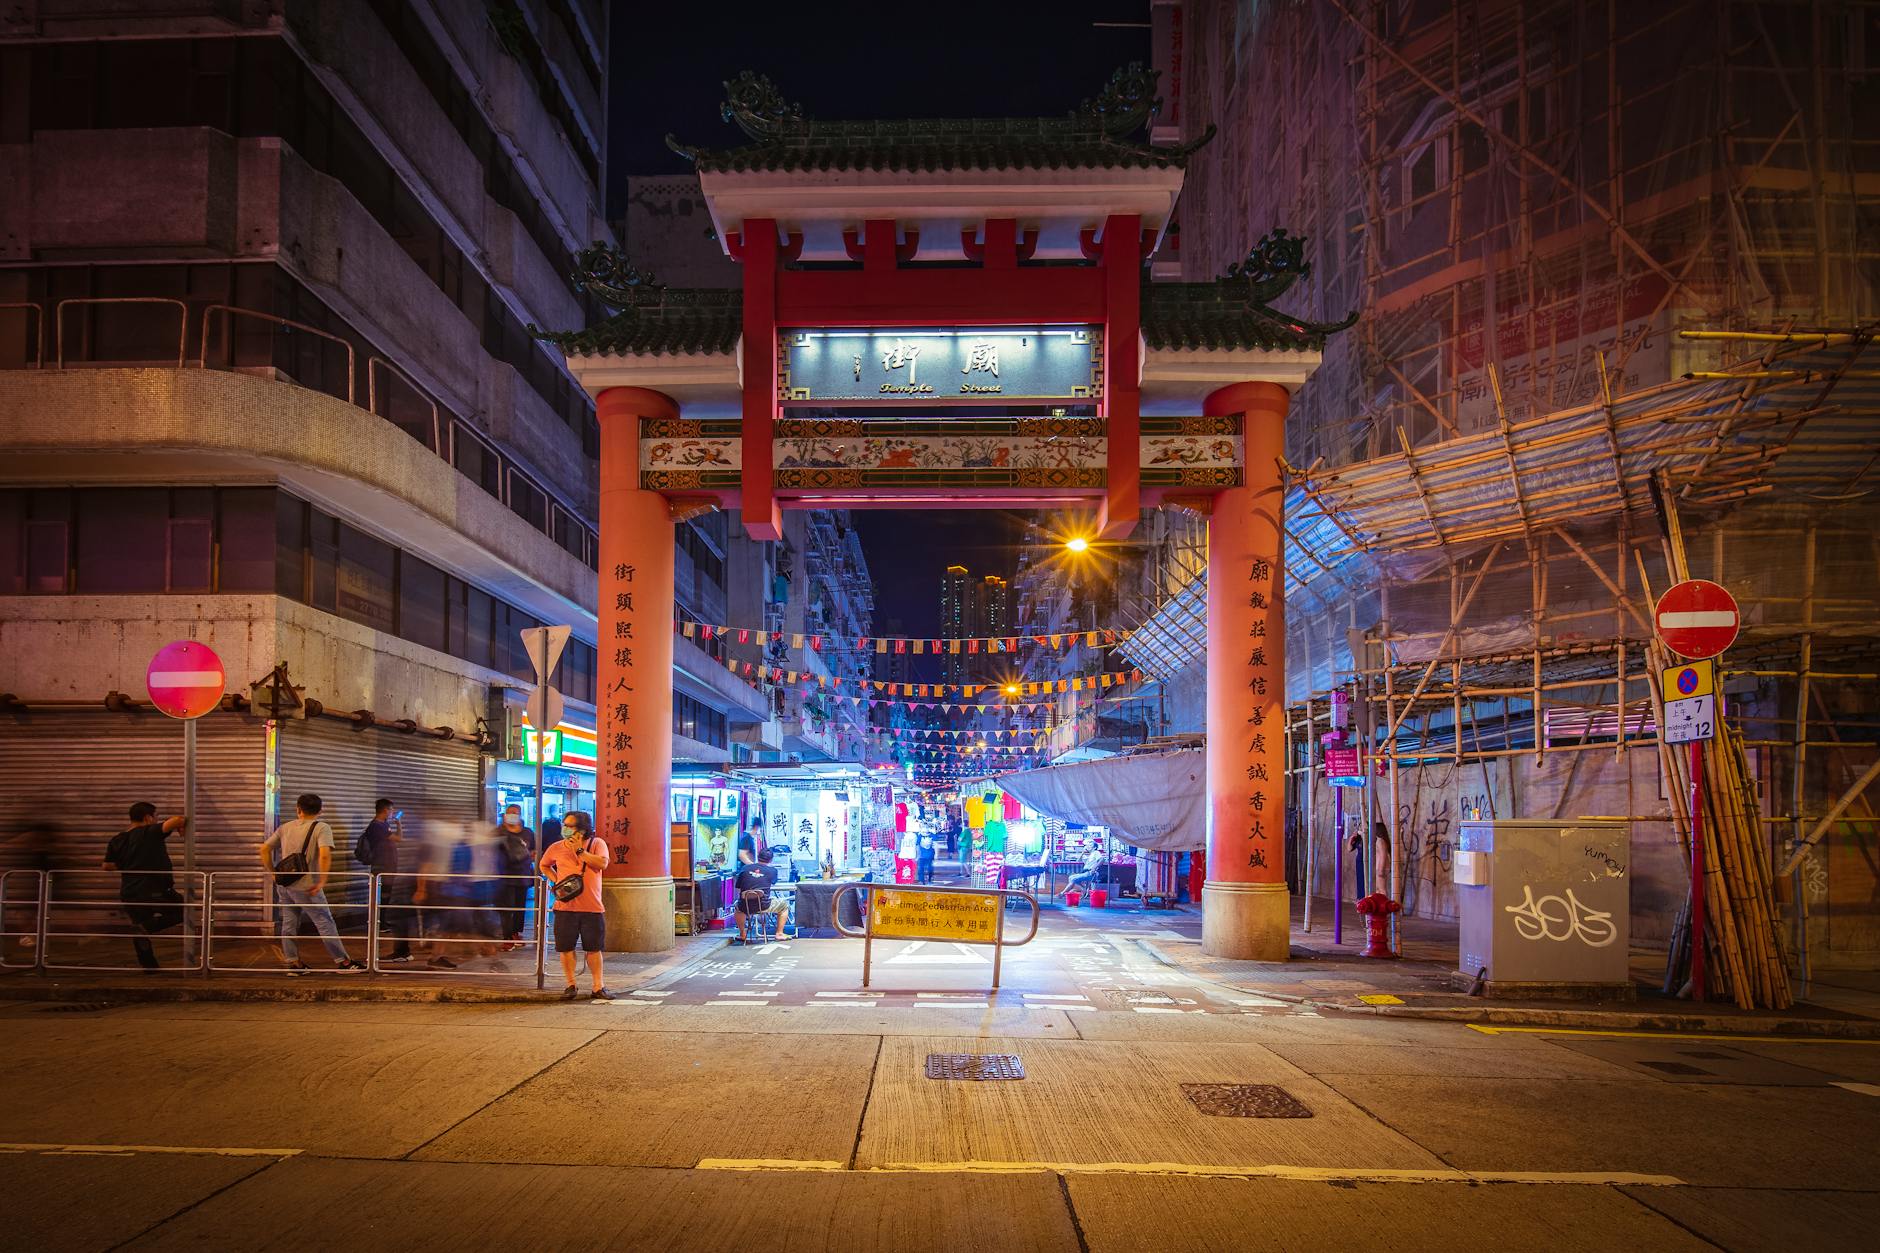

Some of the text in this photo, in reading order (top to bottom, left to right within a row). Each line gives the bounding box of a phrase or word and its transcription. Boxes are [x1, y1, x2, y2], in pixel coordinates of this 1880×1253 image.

[879, 383, 1002, 395] Temple Street
[1694, 699, 1703, 713] 7
[1672, 708, 1687, 718] 上午
[1666, 721, 1710, 736] midnight 12
[922, 901, 970, 912] Pedestrian
[974, 904, 995, 913] Area
[881, 916, 988, 931] 部份時間行人專用區
